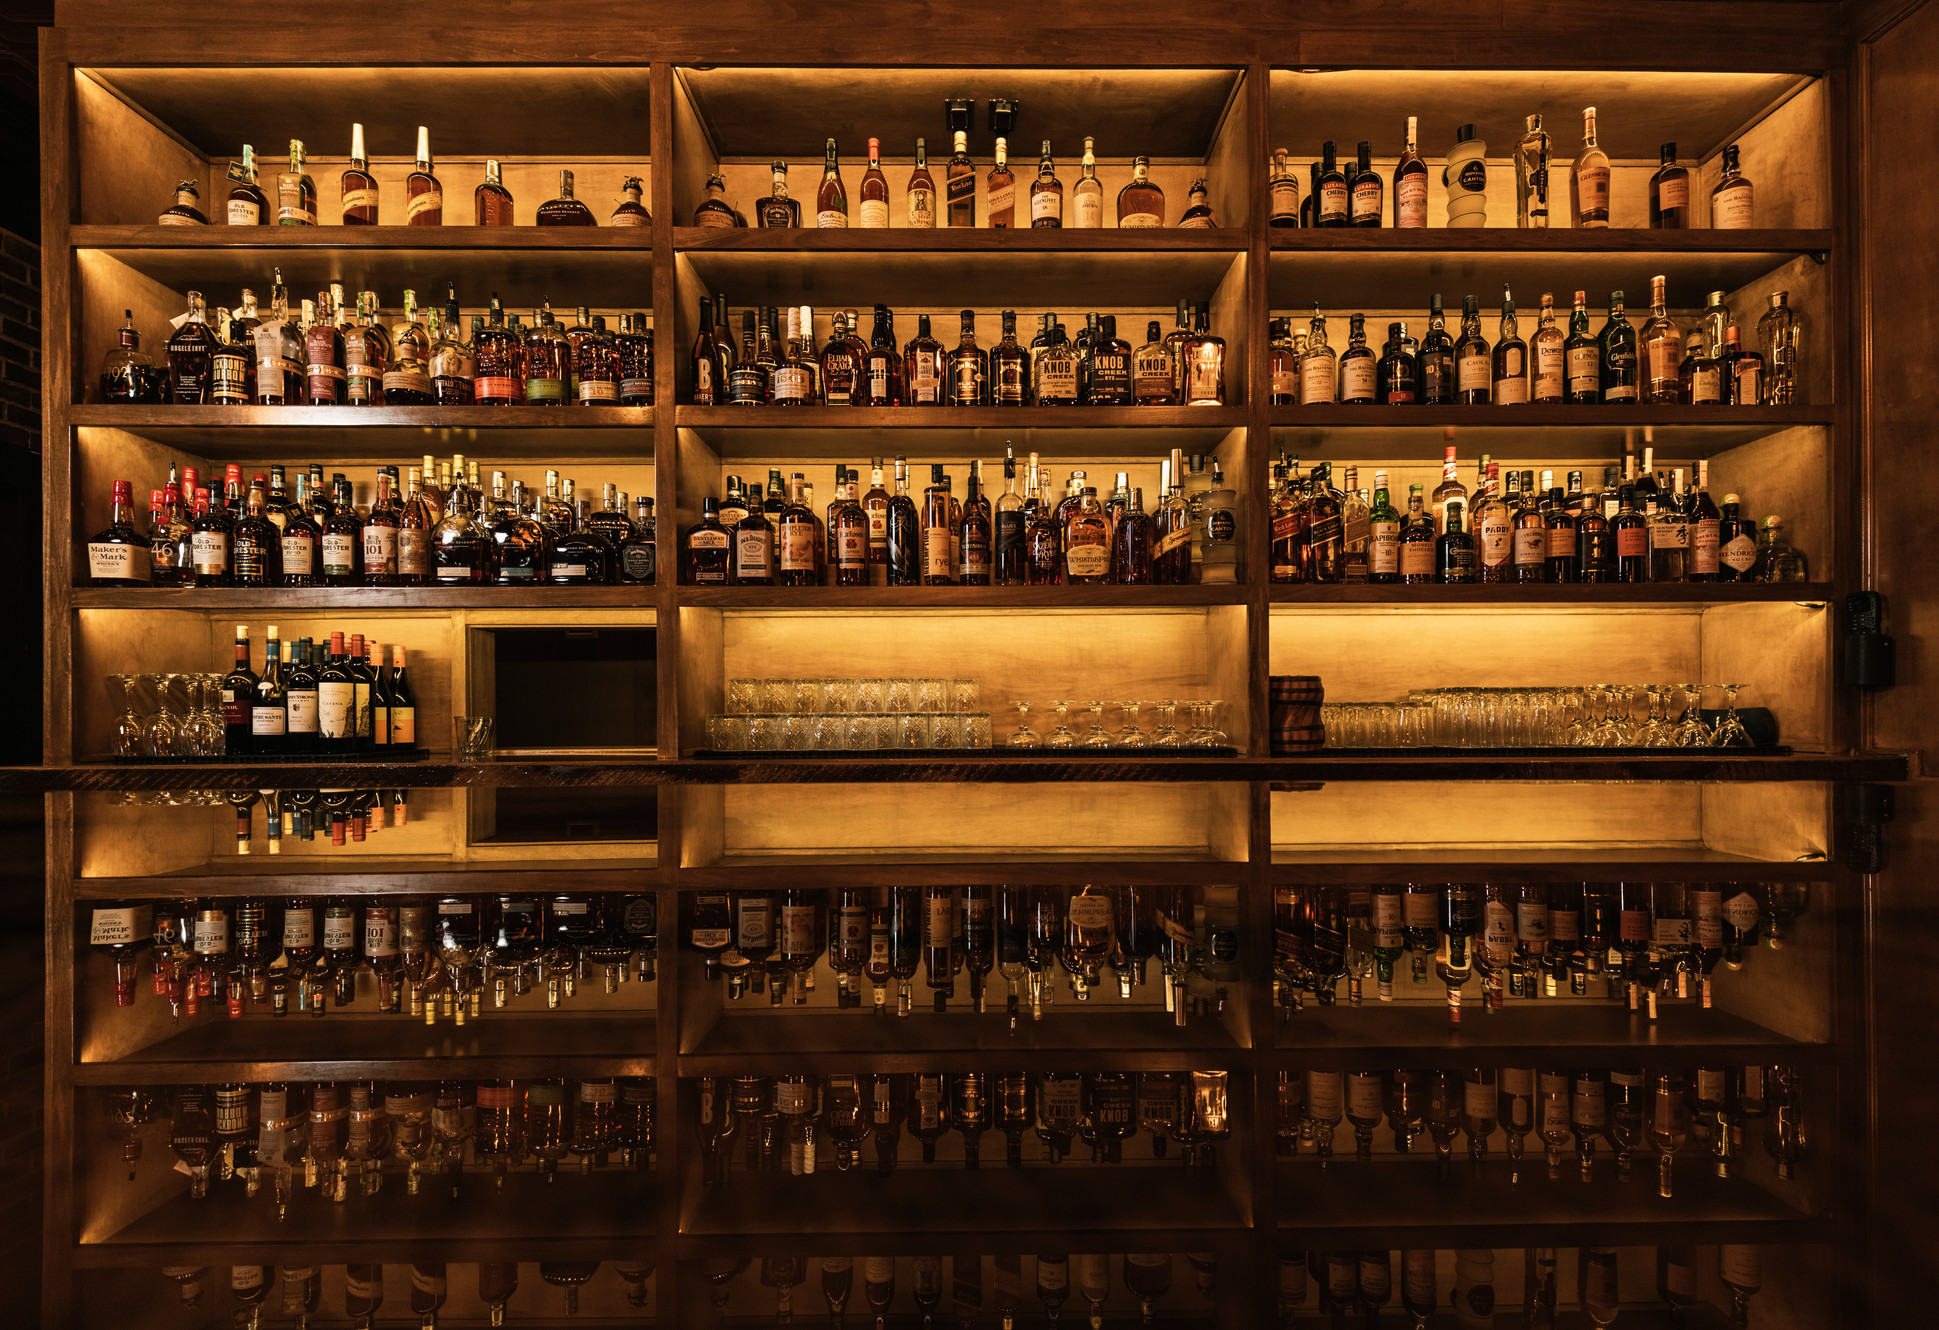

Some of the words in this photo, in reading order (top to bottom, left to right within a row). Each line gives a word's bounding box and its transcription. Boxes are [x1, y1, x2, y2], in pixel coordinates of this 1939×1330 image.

[1324, 182, 1347, 190] LUXARDO
[1354, 182, 1379, 192] LUXARDO
[1044, 361, 1071, 374] KNOB
[1095, 356, 1124, 370] KNOB
[1139, 358, 1166, 371] KNOB
[698, 358, 711, 390] B
[1424, 364, 1435, 375] 10
[1285, 520, 1299, 530] Label
[1485, 526, 1509, 534] PADDY
[91, 546, 128, 554] Maker's
[151, 542, 174, 558] 46
[366, 545, 383, 555] 101
[100, 552, 128, 562] Mark
[935, 558, 949, 568] rye
